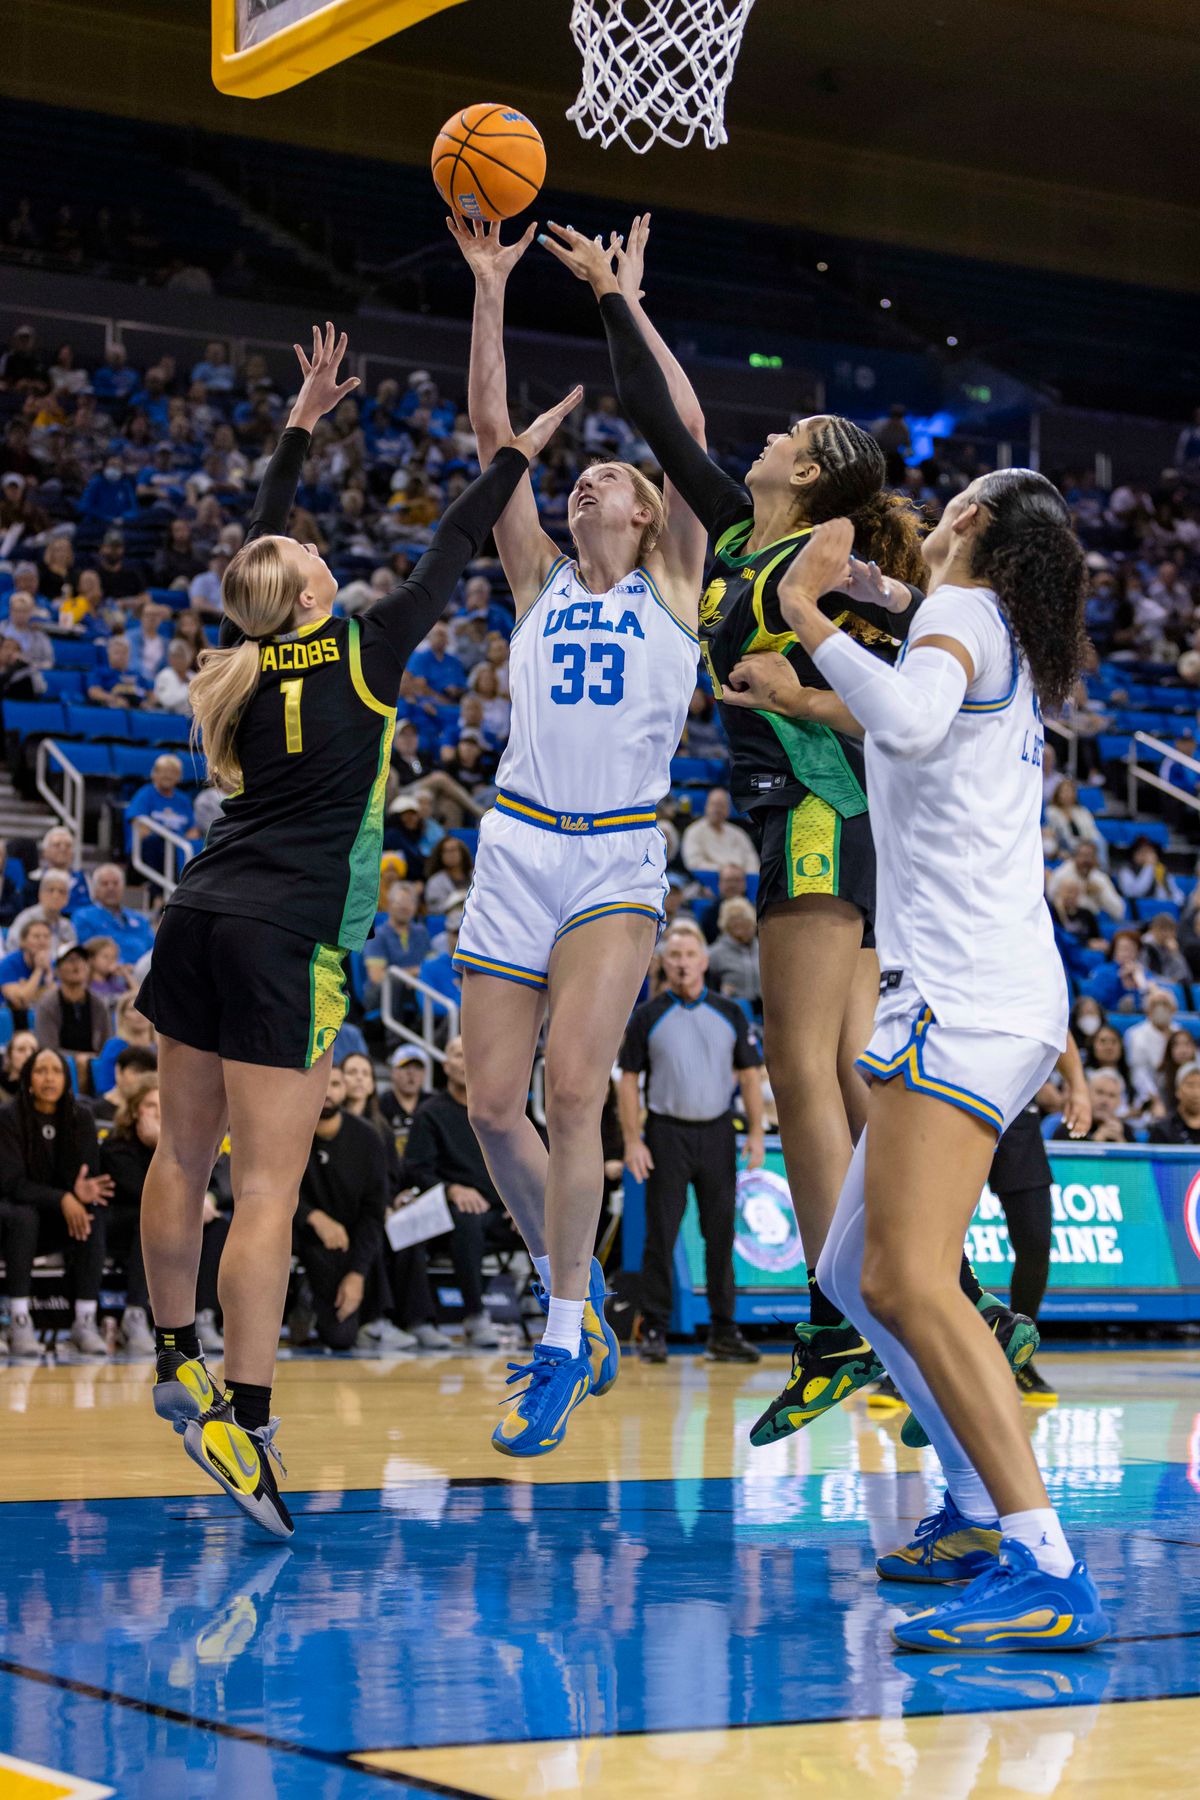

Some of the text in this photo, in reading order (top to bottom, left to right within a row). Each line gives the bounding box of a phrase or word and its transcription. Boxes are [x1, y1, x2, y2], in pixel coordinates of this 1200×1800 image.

[543, 601, 645, 640] UCLA
[260, 638, 340, 672] ACOBS
[551, 643, 625, 706] 33
[280, 677, 304, 754] 1
